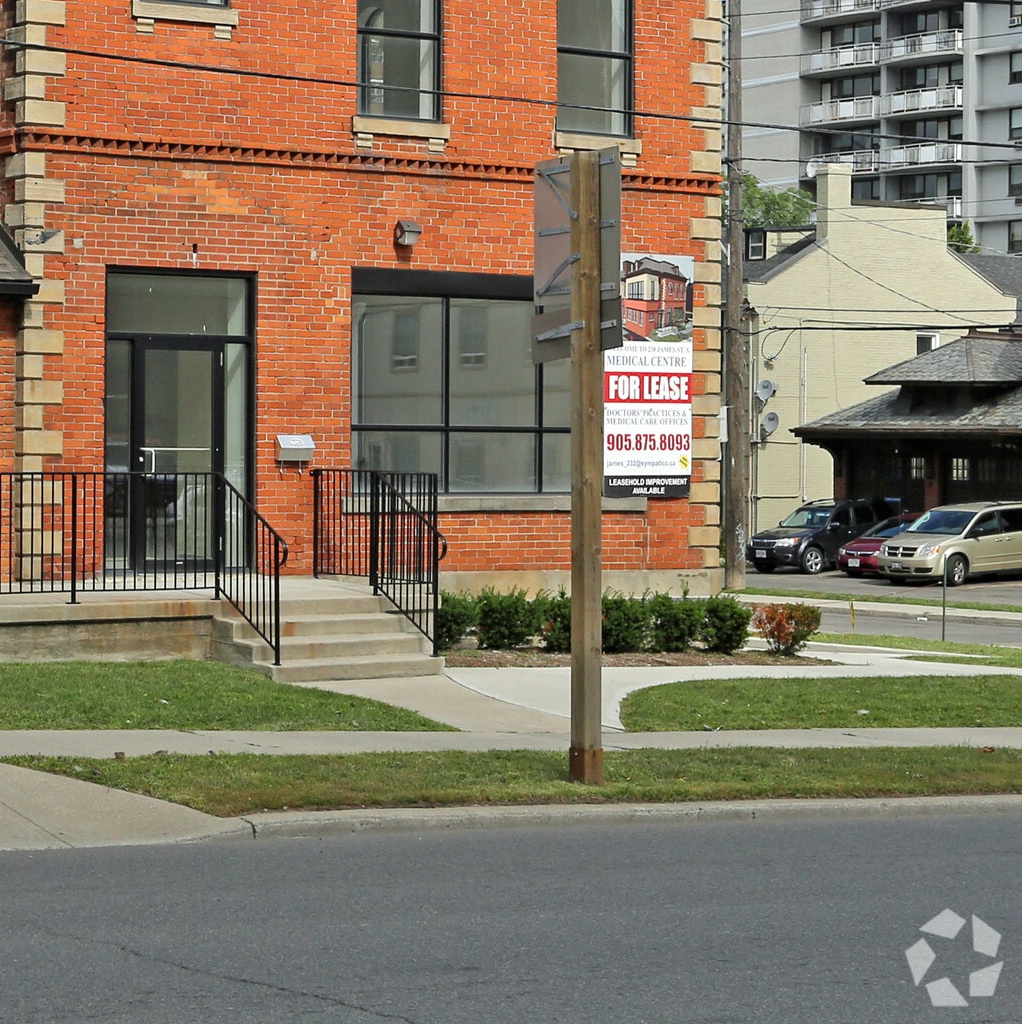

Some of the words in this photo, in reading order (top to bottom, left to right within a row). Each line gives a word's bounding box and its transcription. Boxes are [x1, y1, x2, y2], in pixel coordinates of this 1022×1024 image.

[606, 355, 649, 366] MEDICAL
[651, 356, 687, 367] CENTRE
[608, 375, 640, 400] FOR
[643, 375, 689, 401] LEASE
[643, 409, 681, 417] PRACTICES
[607, 433, 690, 451] 905.875.8093
[609, 478, 645, 486] LEASEHOLD
[645, 478, 687, 486] IMPROVEMENT
